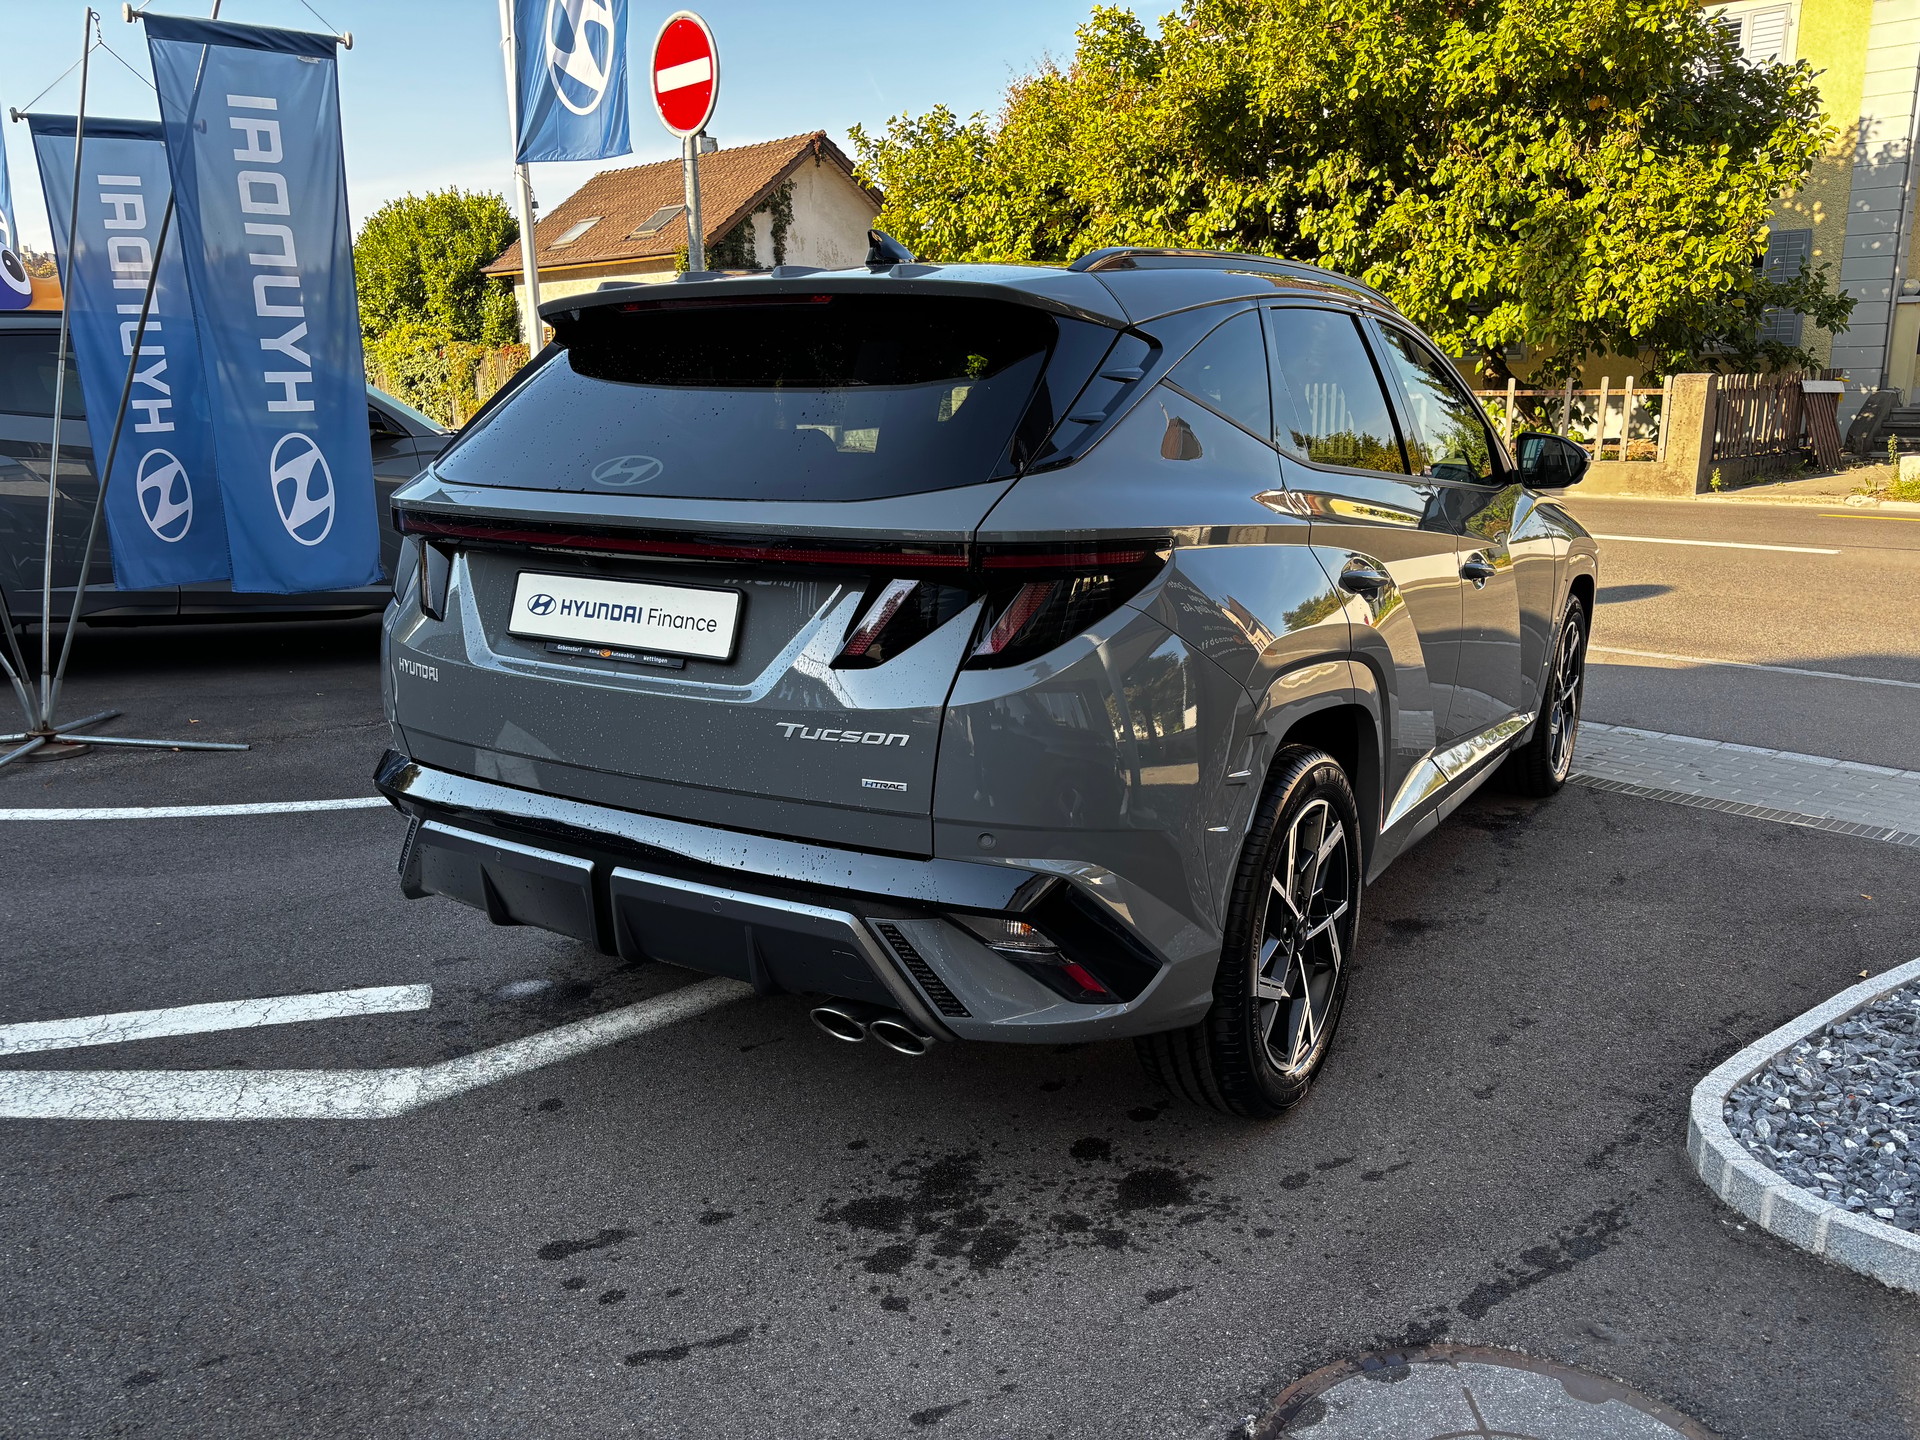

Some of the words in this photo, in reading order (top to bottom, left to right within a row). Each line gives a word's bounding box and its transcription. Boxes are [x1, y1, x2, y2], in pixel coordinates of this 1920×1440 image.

[559, 598, 643, 624] HYUNDAI
[647, 607, 718, 633] Finance
[556, 643, 583, 654] Gebenstorf
[610, 650, 636, 660] Automobile
[642, 654, 668, 665] Wettingen
[398, 656, 439, 683] HYUNDAI
[863, 780, 905, 792] HTRAC
